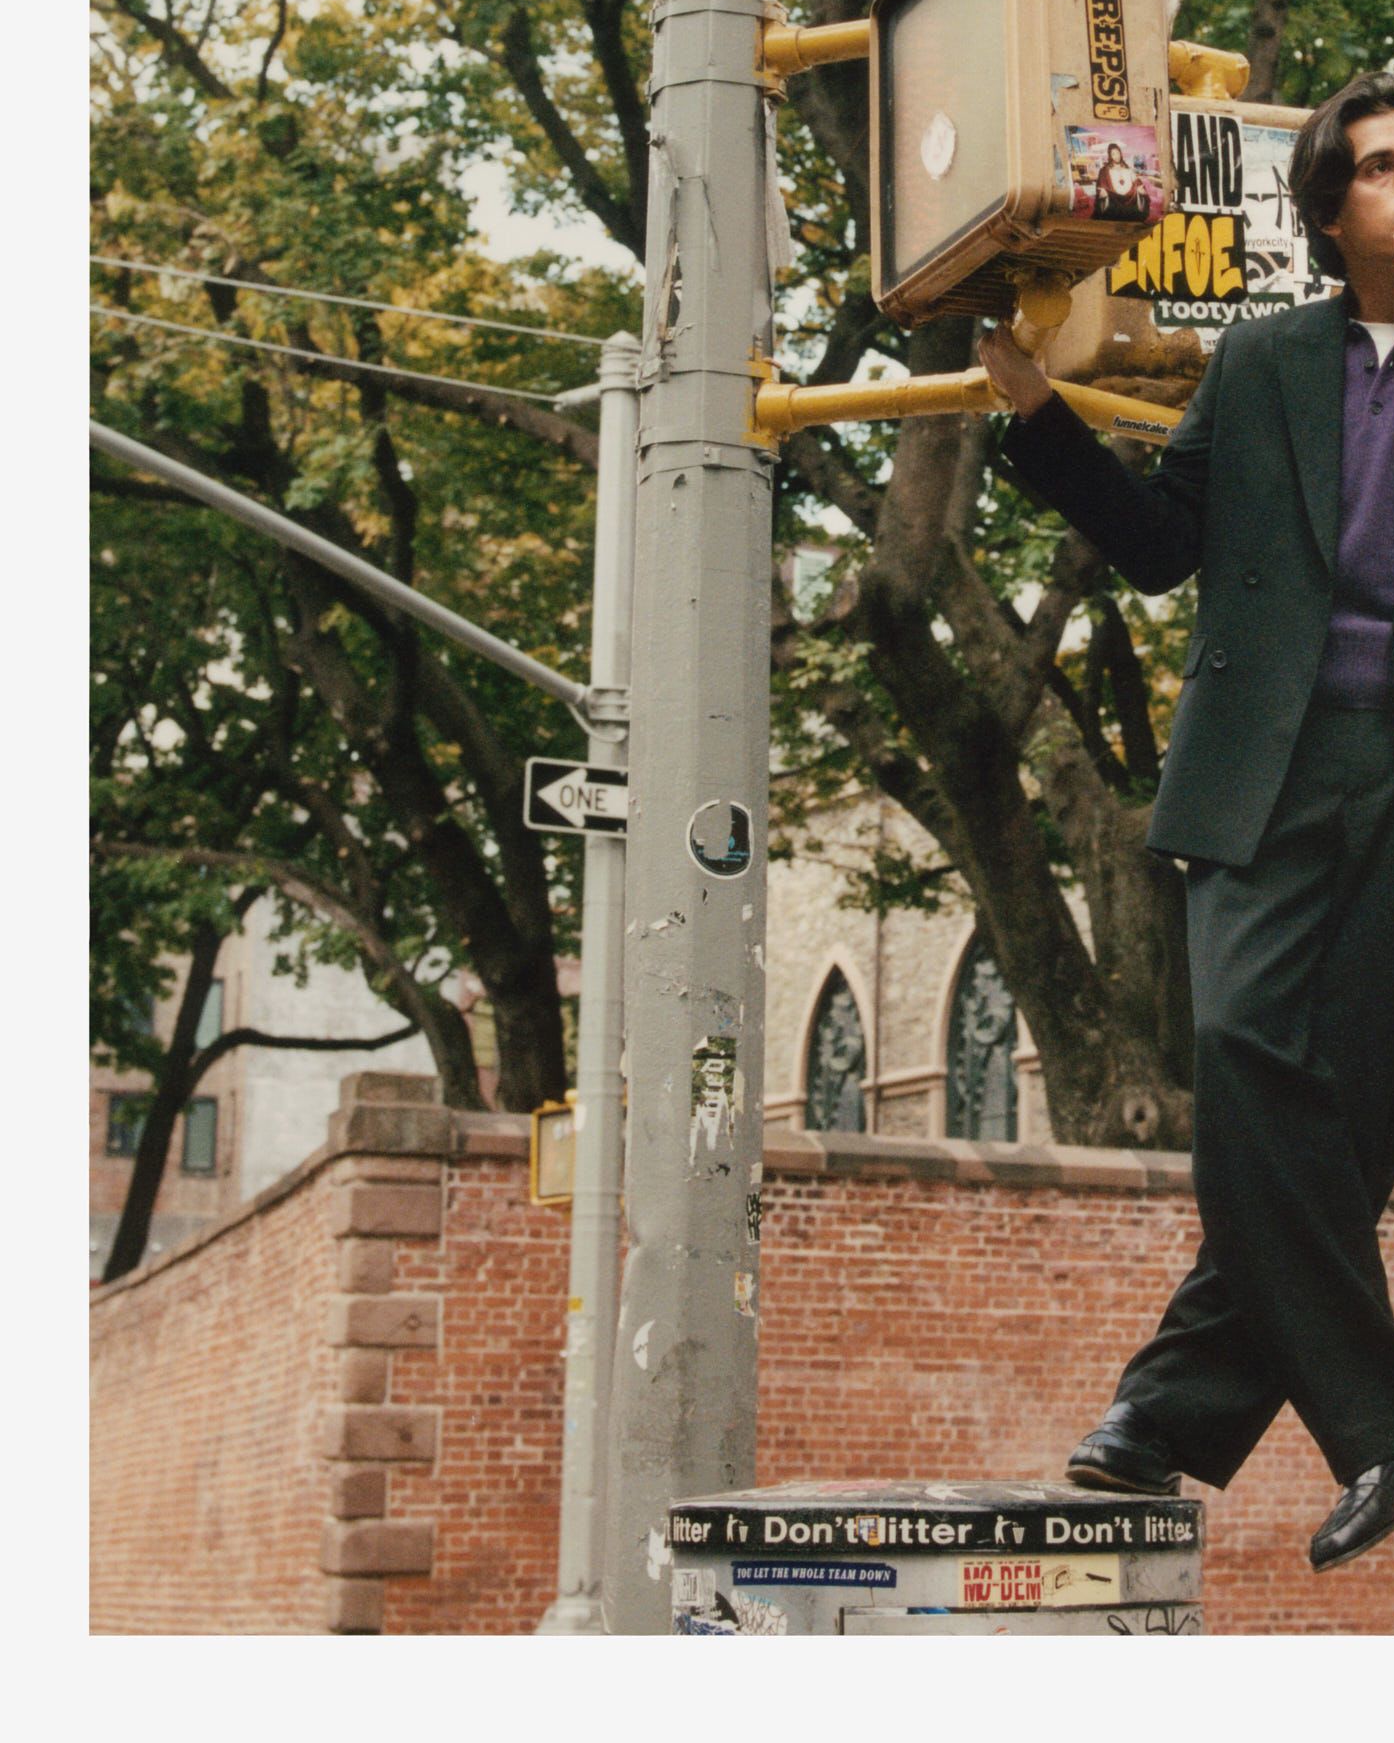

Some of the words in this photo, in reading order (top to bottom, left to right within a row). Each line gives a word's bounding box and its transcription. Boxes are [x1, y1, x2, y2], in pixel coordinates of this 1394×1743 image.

[560, 784, 607, 812] ONE
[673, 1516, 711, 1543] litter
[764, 1516, 858, 1544] Don't
[879, 1516, 973, 1544] litter
[1045, 1516, 1133, 1544] Don't
[1145, 1516, 1193, 1541] litter
[753, 1567, 769, 1579] LET
[771, 1567, 789, 1578] THE
[791, 1567, 825, 1579] WHOLE
[828, 1568, 856, 1580] TEAM
[859, 1569, 892, 1581] DOWN
